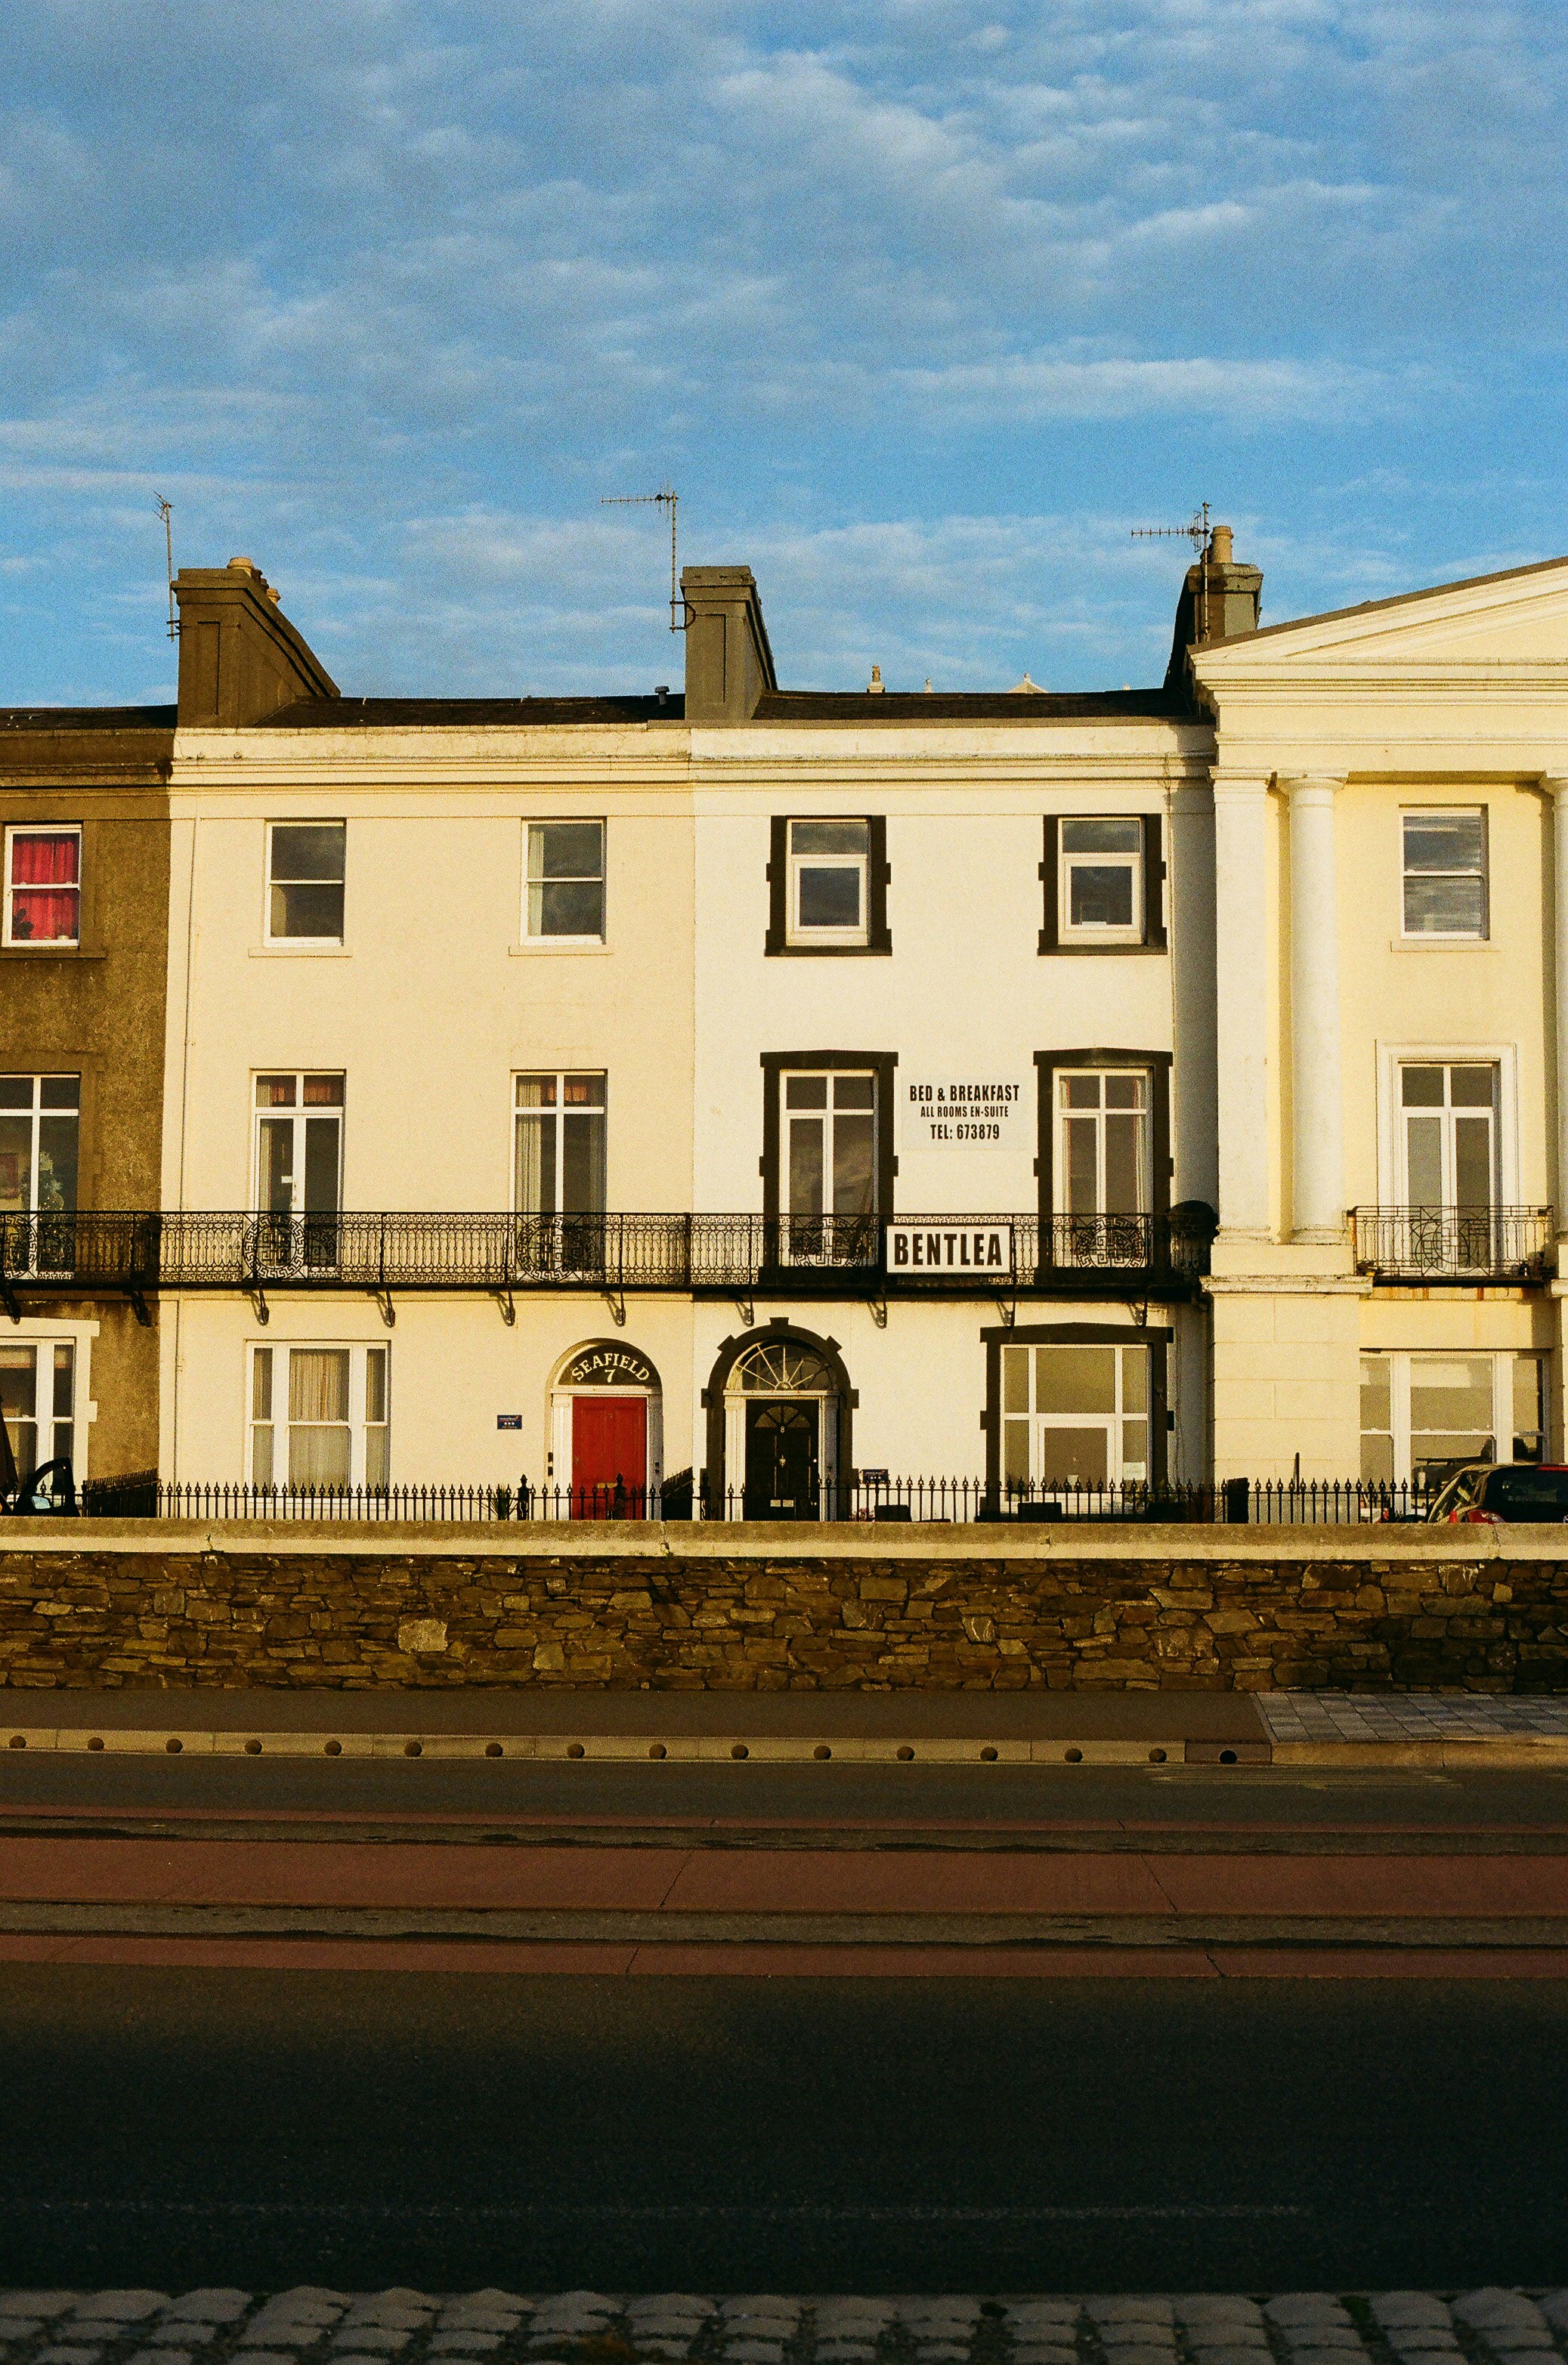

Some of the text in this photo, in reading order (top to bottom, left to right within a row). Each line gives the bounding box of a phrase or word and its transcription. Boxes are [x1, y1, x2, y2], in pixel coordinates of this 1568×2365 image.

[909, 1084, 1019, 1102] BED & BREAKFAST
[920, 1105, 1009, 1118] ALL ROOMS EN-SUITE
[930, 1124, 1000, 1140] TEL: 673879
[894, 1233, 1002, 1266] BENTLEA
[571, 1353, 650, 1381] SEAFIELD
[605, 1368, 616, 1383] 7
